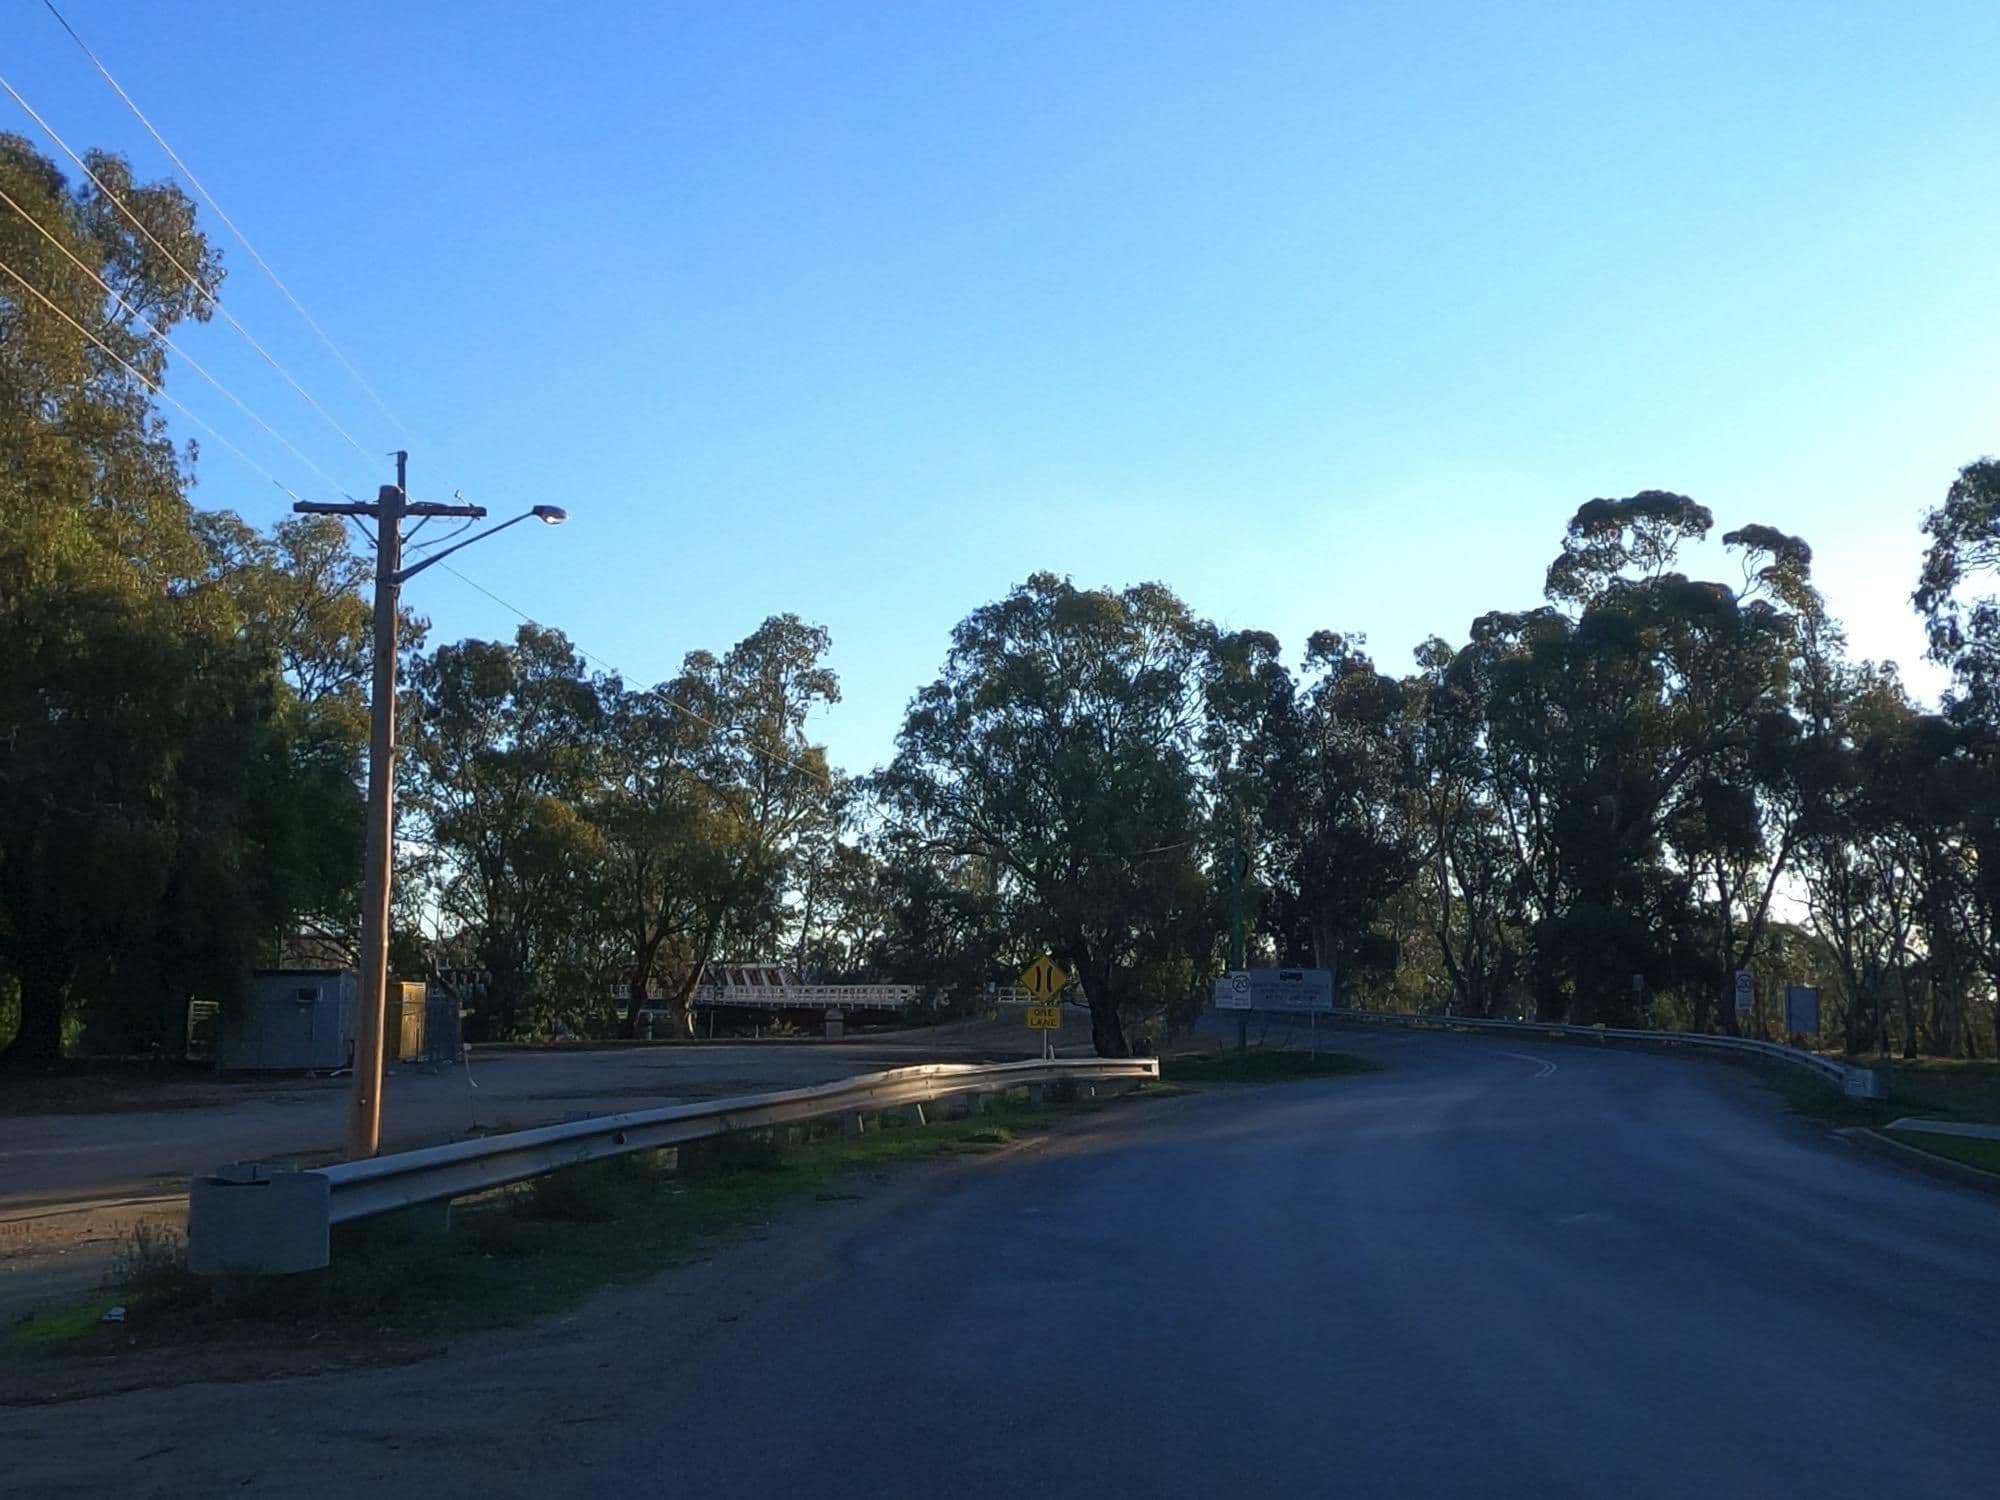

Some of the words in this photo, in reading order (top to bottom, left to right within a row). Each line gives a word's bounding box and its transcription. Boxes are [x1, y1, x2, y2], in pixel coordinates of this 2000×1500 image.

[1234, 979, 1248, 989] 20
[1033, 1008, 1055, 1017] ONE
[1031, 1018, 1057, 1027] LANE
